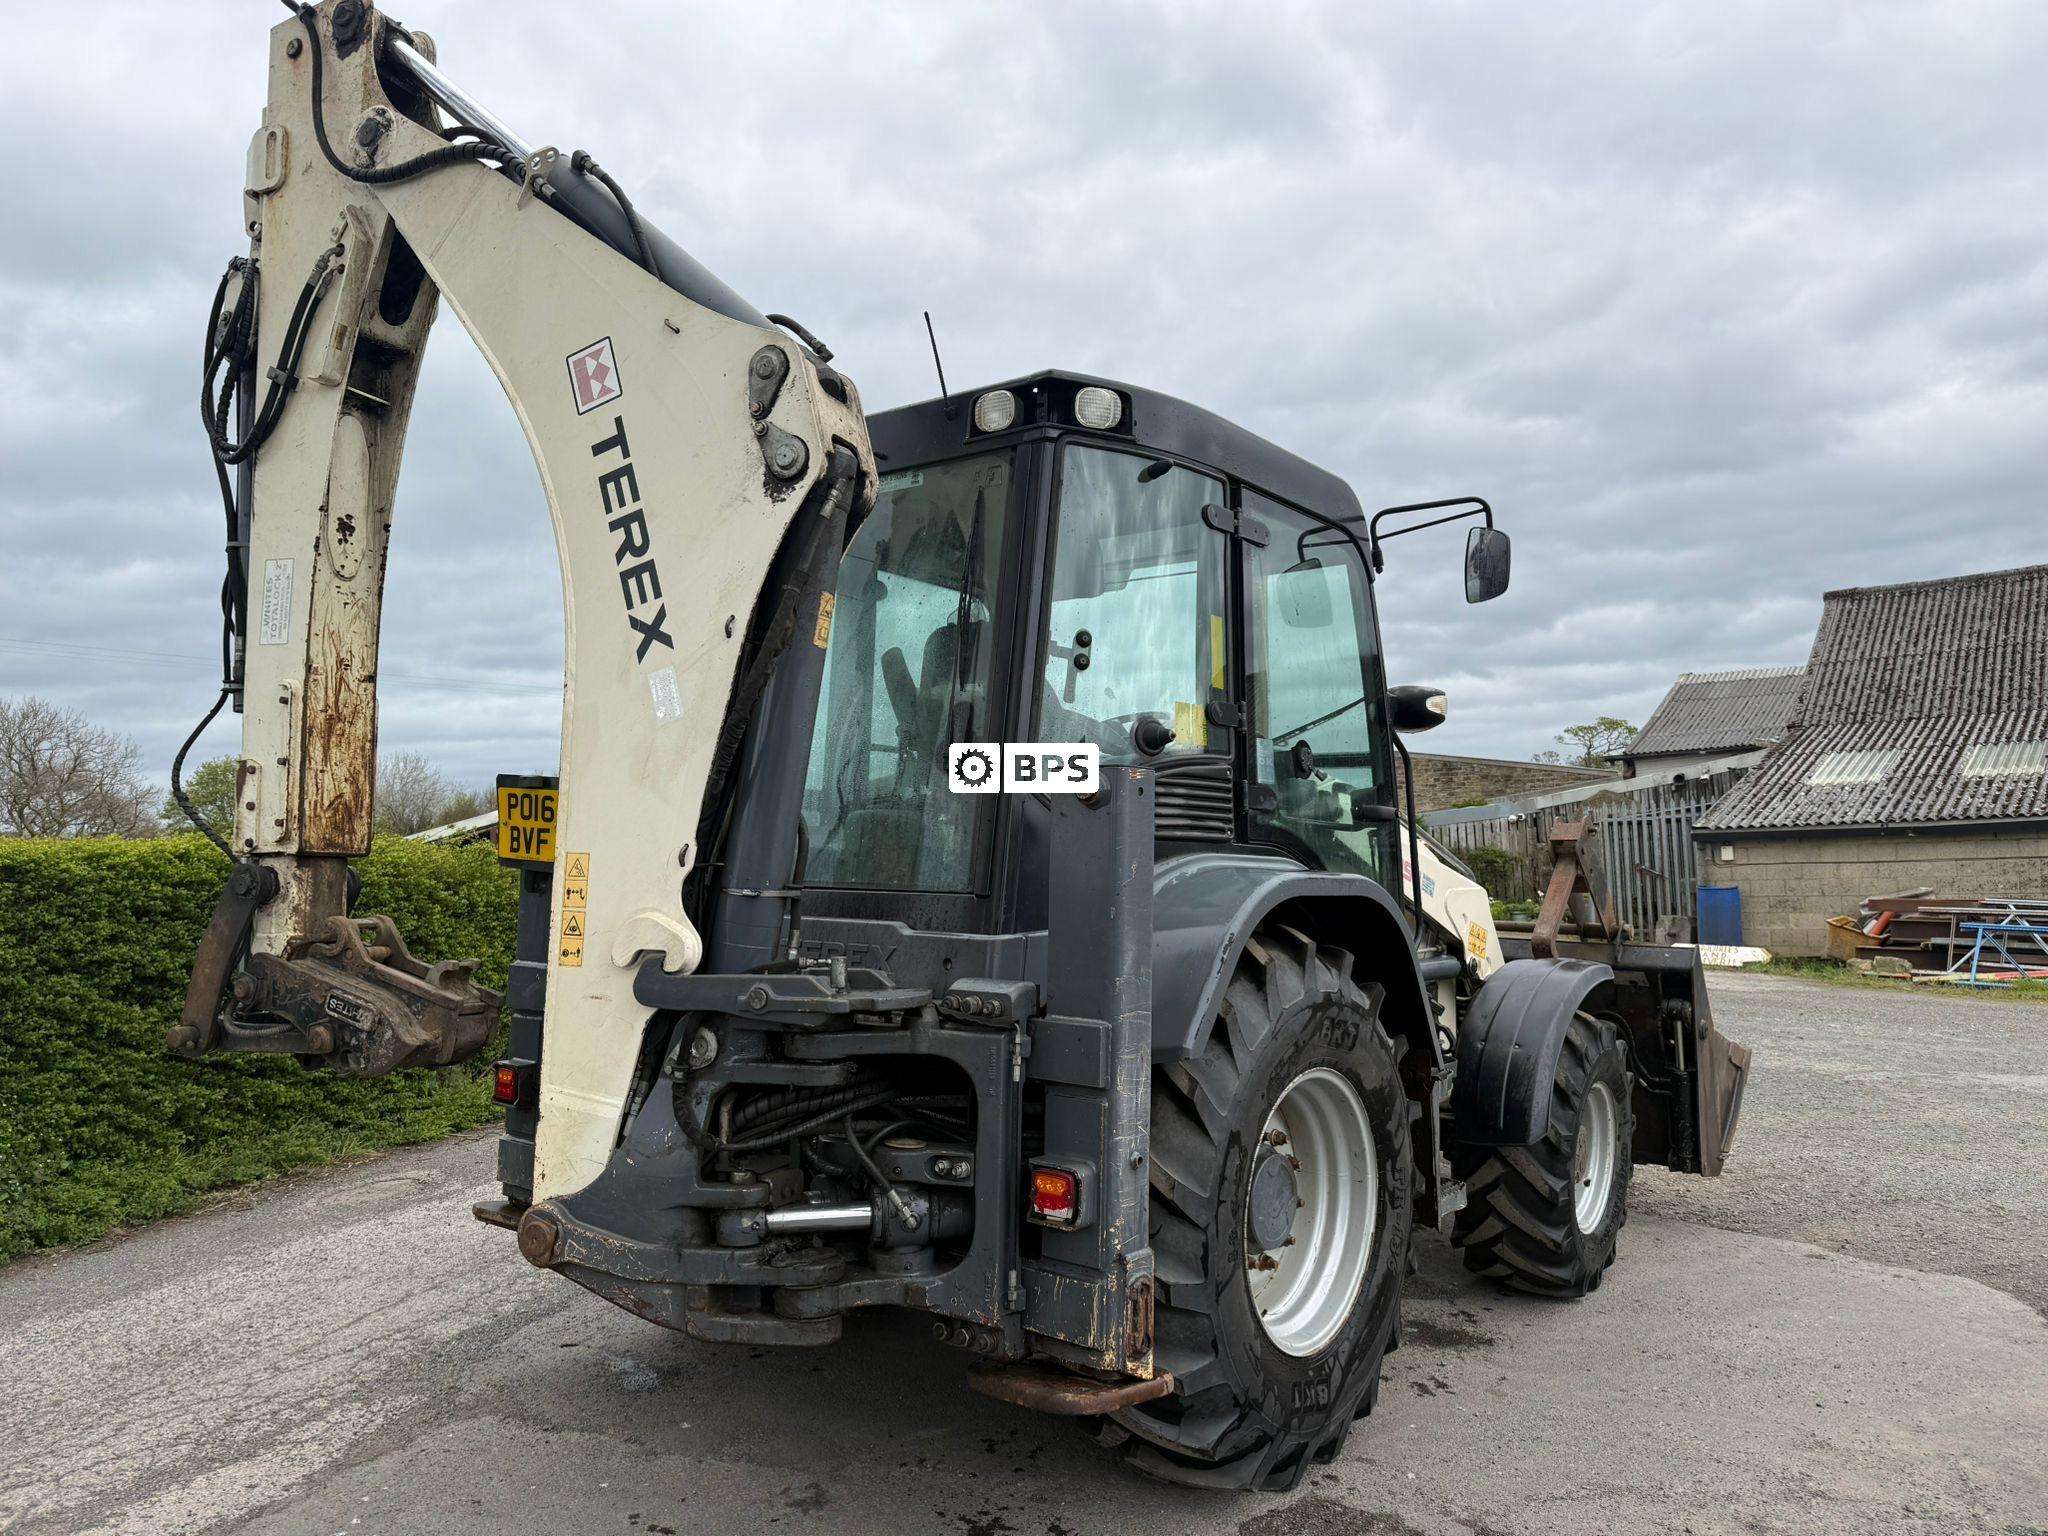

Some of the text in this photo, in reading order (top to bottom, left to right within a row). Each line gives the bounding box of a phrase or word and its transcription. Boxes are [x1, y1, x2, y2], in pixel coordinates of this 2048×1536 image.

[591, 415, 675, 665] TEREX
[506, 793, 555, 823] PO16
[509, 825, 551, 855] BVF
[798, 938, 898, 975] EREX
[1294, 1384, 1328, 1408] BKT
